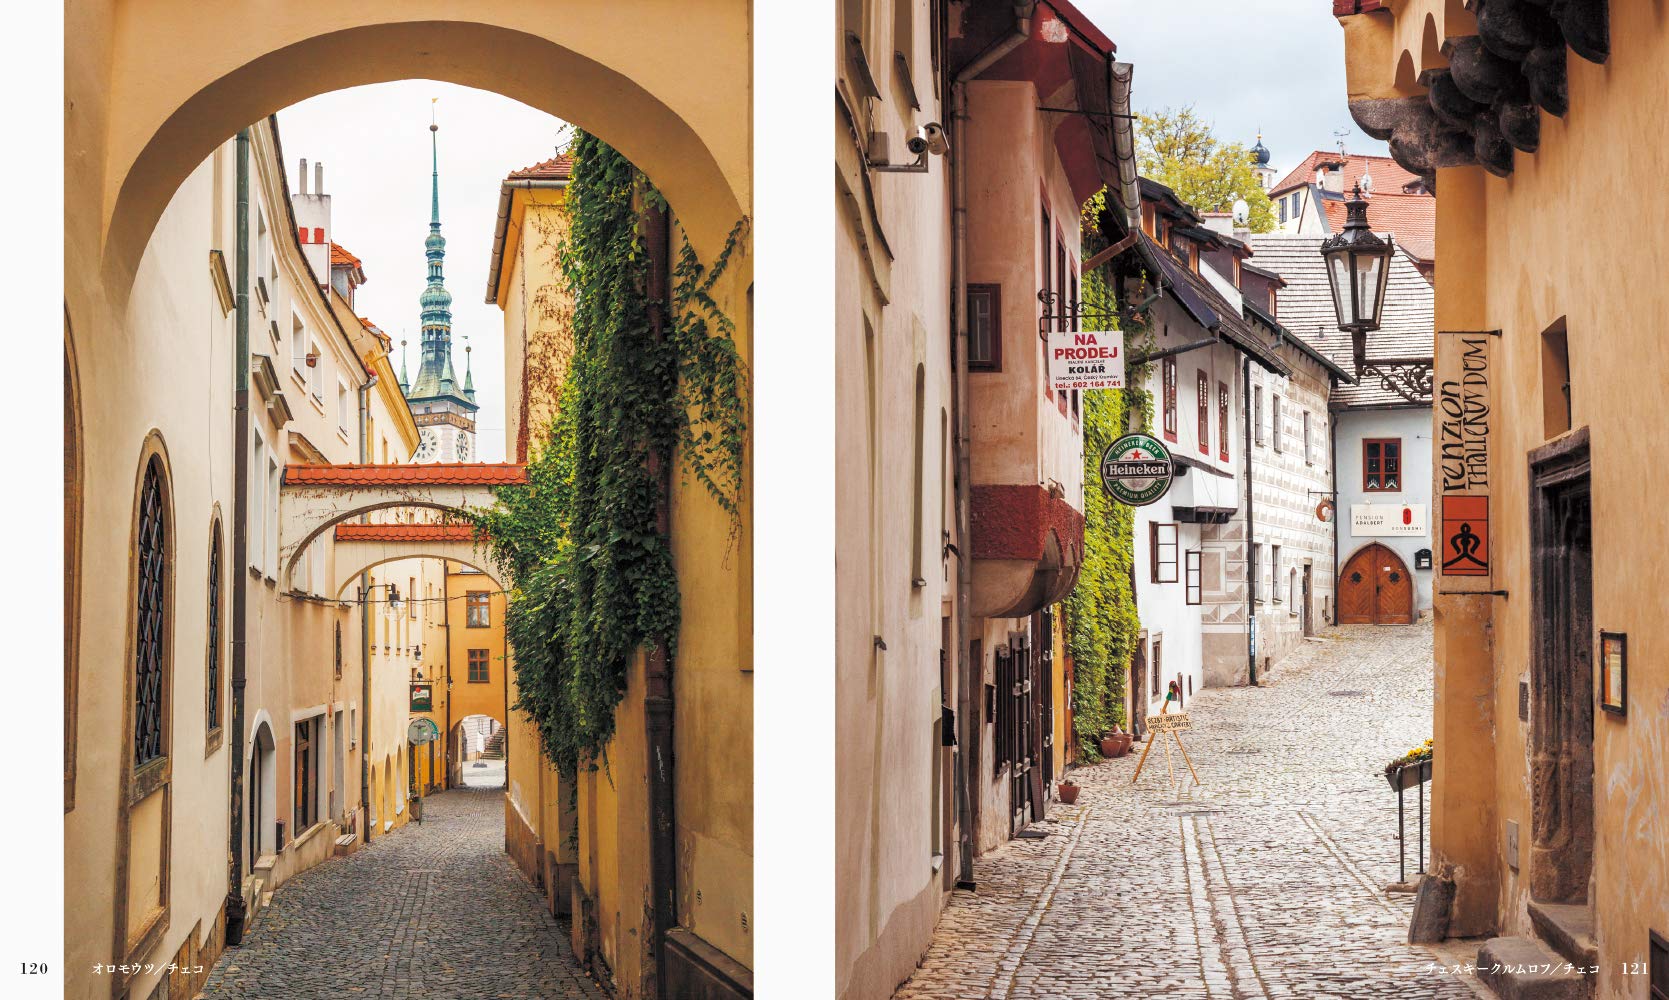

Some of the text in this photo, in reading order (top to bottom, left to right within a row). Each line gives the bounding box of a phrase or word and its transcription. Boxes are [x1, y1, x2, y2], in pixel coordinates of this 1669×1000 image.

[1075, 334, 1097, 345] NA
[1054, 347, 1118, 360] PRODEJ
[1068, 363, 1106, 374] KOLÁŘ
[1109, 464, 1166, 475] Heineken
[1140, 482, 1162, 498] QUALITY
